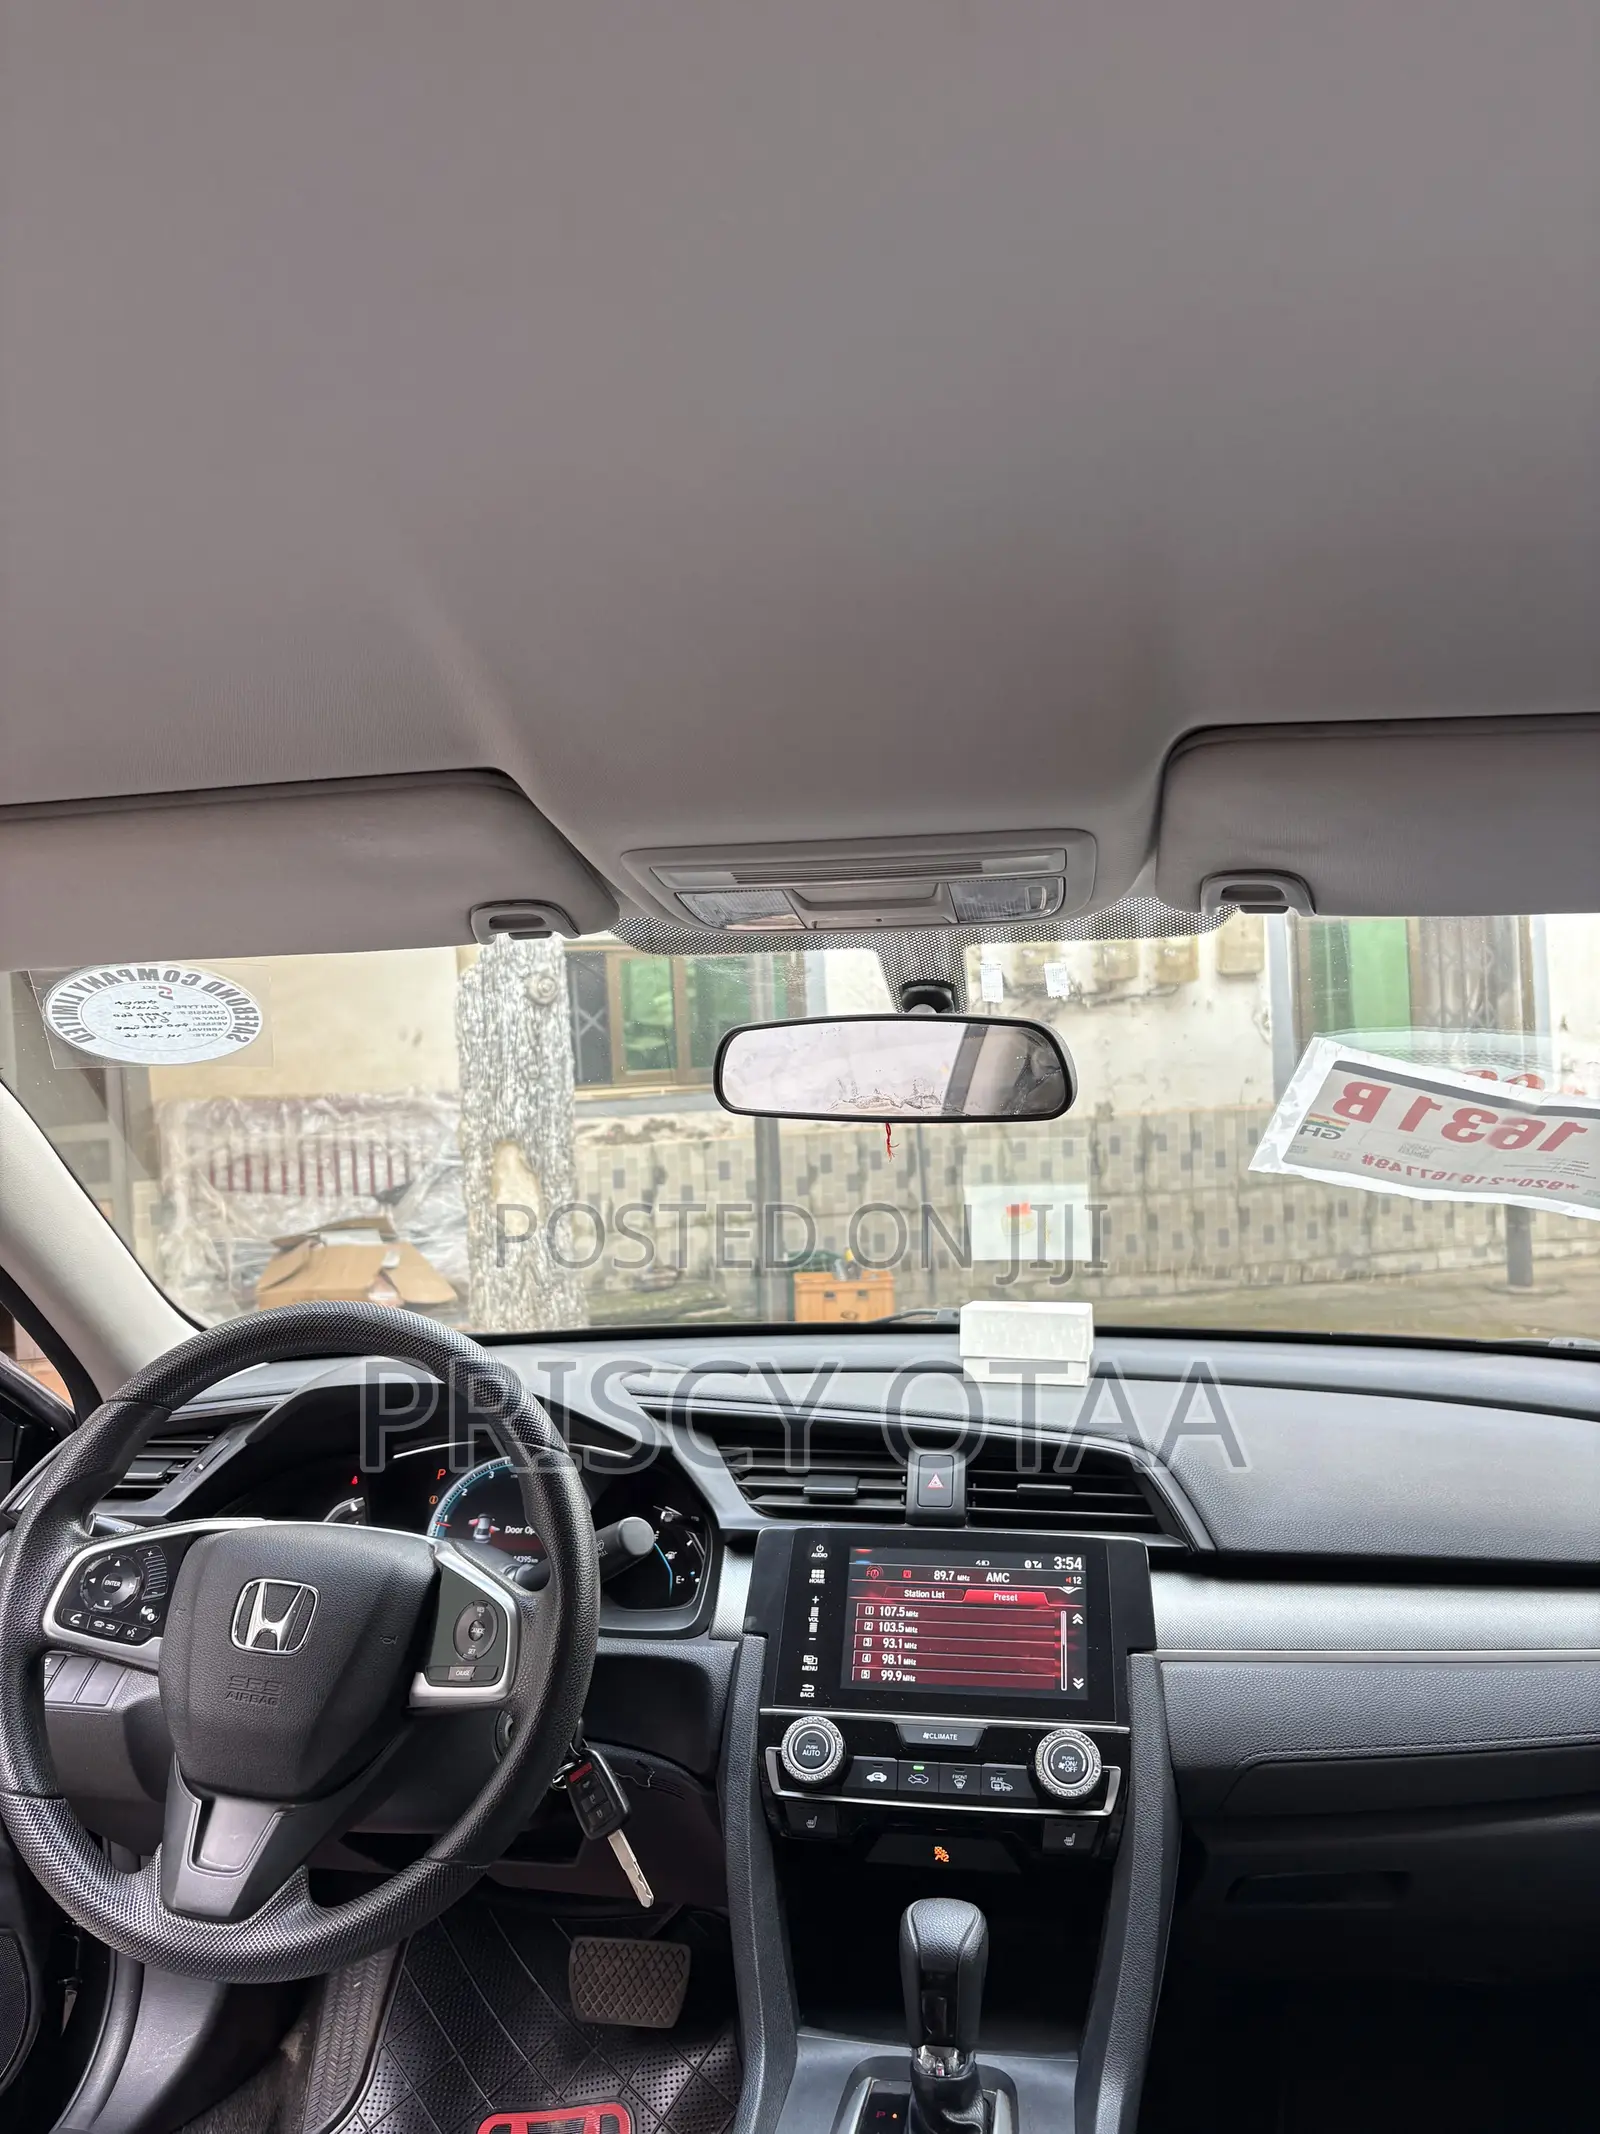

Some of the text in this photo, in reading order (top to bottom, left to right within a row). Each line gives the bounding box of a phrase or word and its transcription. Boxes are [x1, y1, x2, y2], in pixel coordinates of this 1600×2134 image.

[436, 1469, 446, 1479] P
[505, 1526, 523, 1534] Door
[1053, 1556, 1082, 1570] 3:54
[104, 1579, 121, 1587] ENTER
[933, 1570, 955, 1580] 89.7
[985, 1572, 1010, 1583] AMC
[1072, 1576, 1082, 1584] 12
[904, 1589, 1018, 1601] Station List Preset
[880, 1605, 905, 1617] 107.5
[905, 1610, 919, 1618] MHz
[879, 1621, 904, 1633] 103.5
[905, 1626, 918, 1634] MHz
[882, 1637, 903, 1649] 93.1
[904, 1642, 917, 1650] MHz
[881, 1653, 902, 1665] 98.1
[903, 1658, 917, 1666] MHz
[880, 1669, 903, 1681] 99.9
[902, 1674, 916, 1682] MHz
[225, 1691, 279, 1705] AIRBAG
[929, 1732, 958, 1741] CLIMATE
[802, 1749, 821, 1757] AUTO
